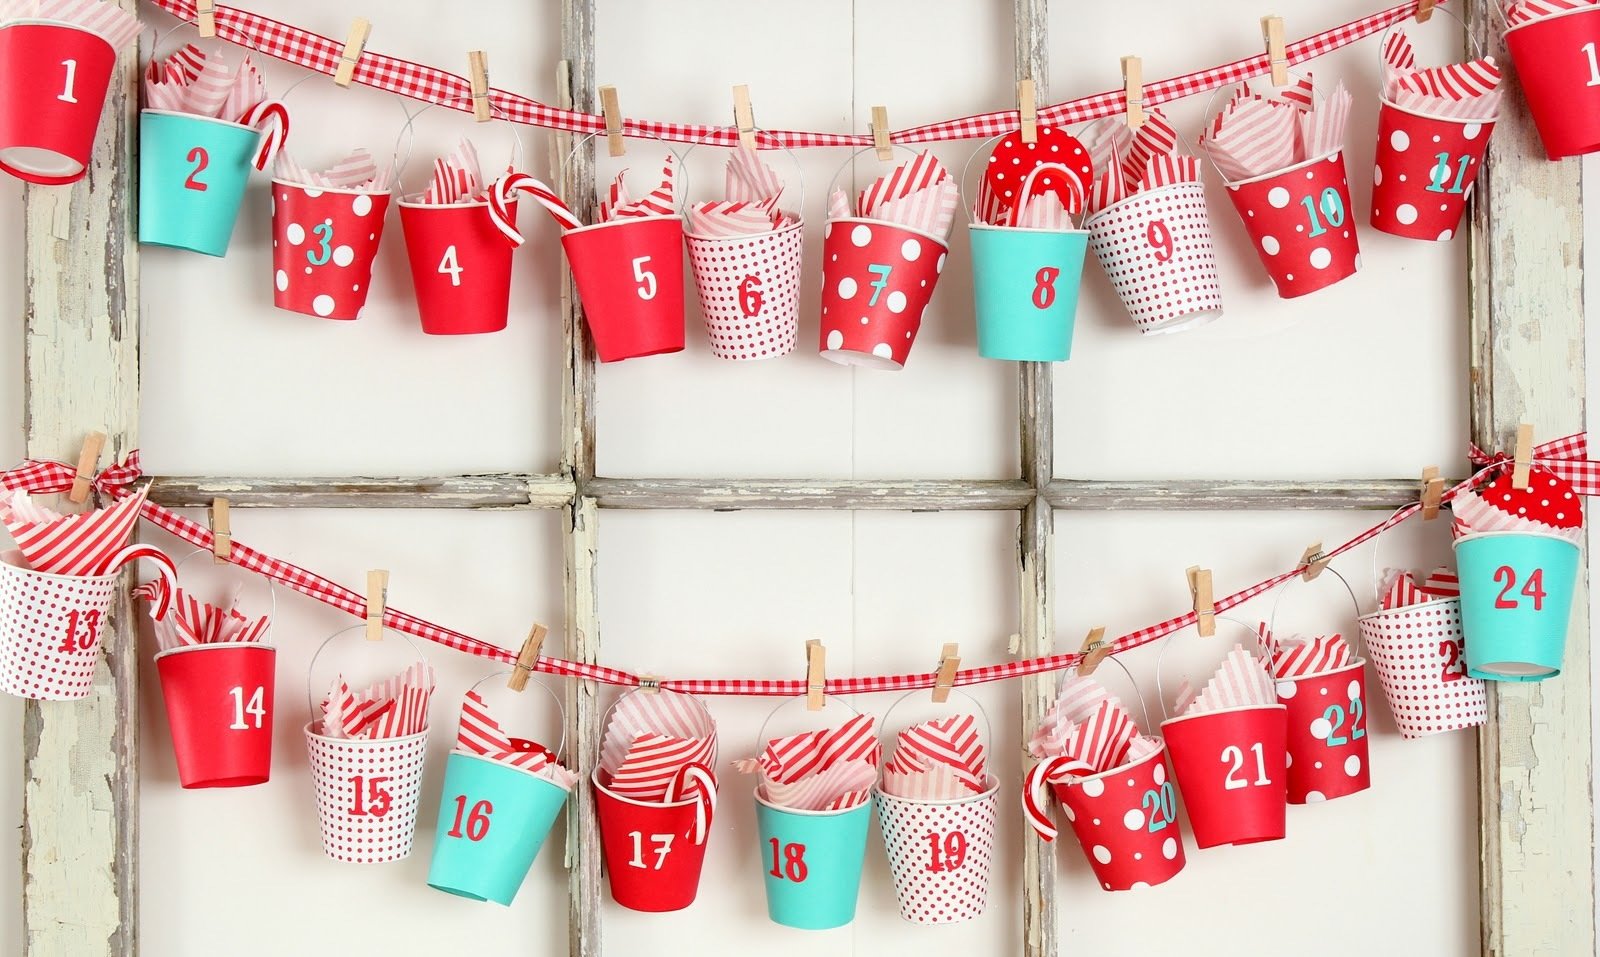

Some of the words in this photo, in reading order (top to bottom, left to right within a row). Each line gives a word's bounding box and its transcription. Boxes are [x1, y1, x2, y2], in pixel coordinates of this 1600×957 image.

[57, 59, 78, 104] 1
[184, 146, 208, 192] 2
[1425, 151, 1468, 196] 11
[1301, 187, 1345, 239] 10
[306, 223, 334, 266] 3
[1146, 219, 1174, 262] 9
[438, 245, 463, 287] 4
[631, 256, 657, 300] 5
[867, 264, 893, 307] 7
[1032, 266, 1059, 309] 8
[738, 274, 764, 317] 6
[1493, 565, 1547, 611] 24
[58, 607, 99, 655] 13
[229, 685, 266, 731] 14
[1323, 696, 1366, 747] 22
[1220, 742, 1272, 790] 21
[348, 775, 393, 817] 15
[447, 794, 493, 842] 16
[1141, 781, 1176, 834] 20
[627, 830, 675, 871] 17
[768, 837, 808, 883] 18
[924, 830, 967, 872] 19
